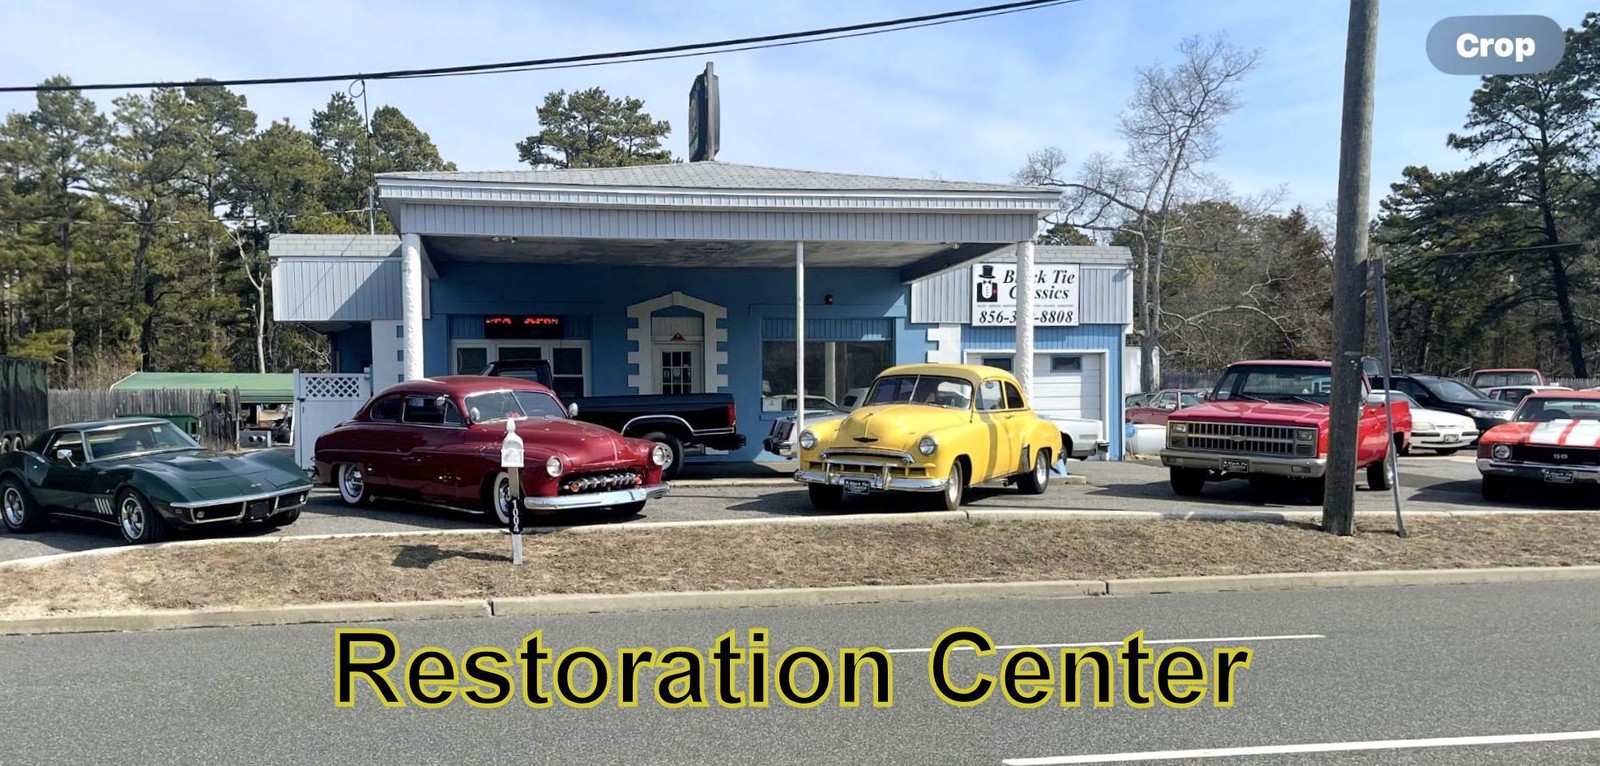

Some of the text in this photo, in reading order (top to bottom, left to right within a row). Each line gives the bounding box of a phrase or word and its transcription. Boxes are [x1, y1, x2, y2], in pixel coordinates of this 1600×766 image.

[1053, 270, 1075, 284] Tie
[1009, 286, 1069, 299] Cssics
[979, 311, 1073, 323] 856-3-8808
[512, 499, 520, 533] 1004
